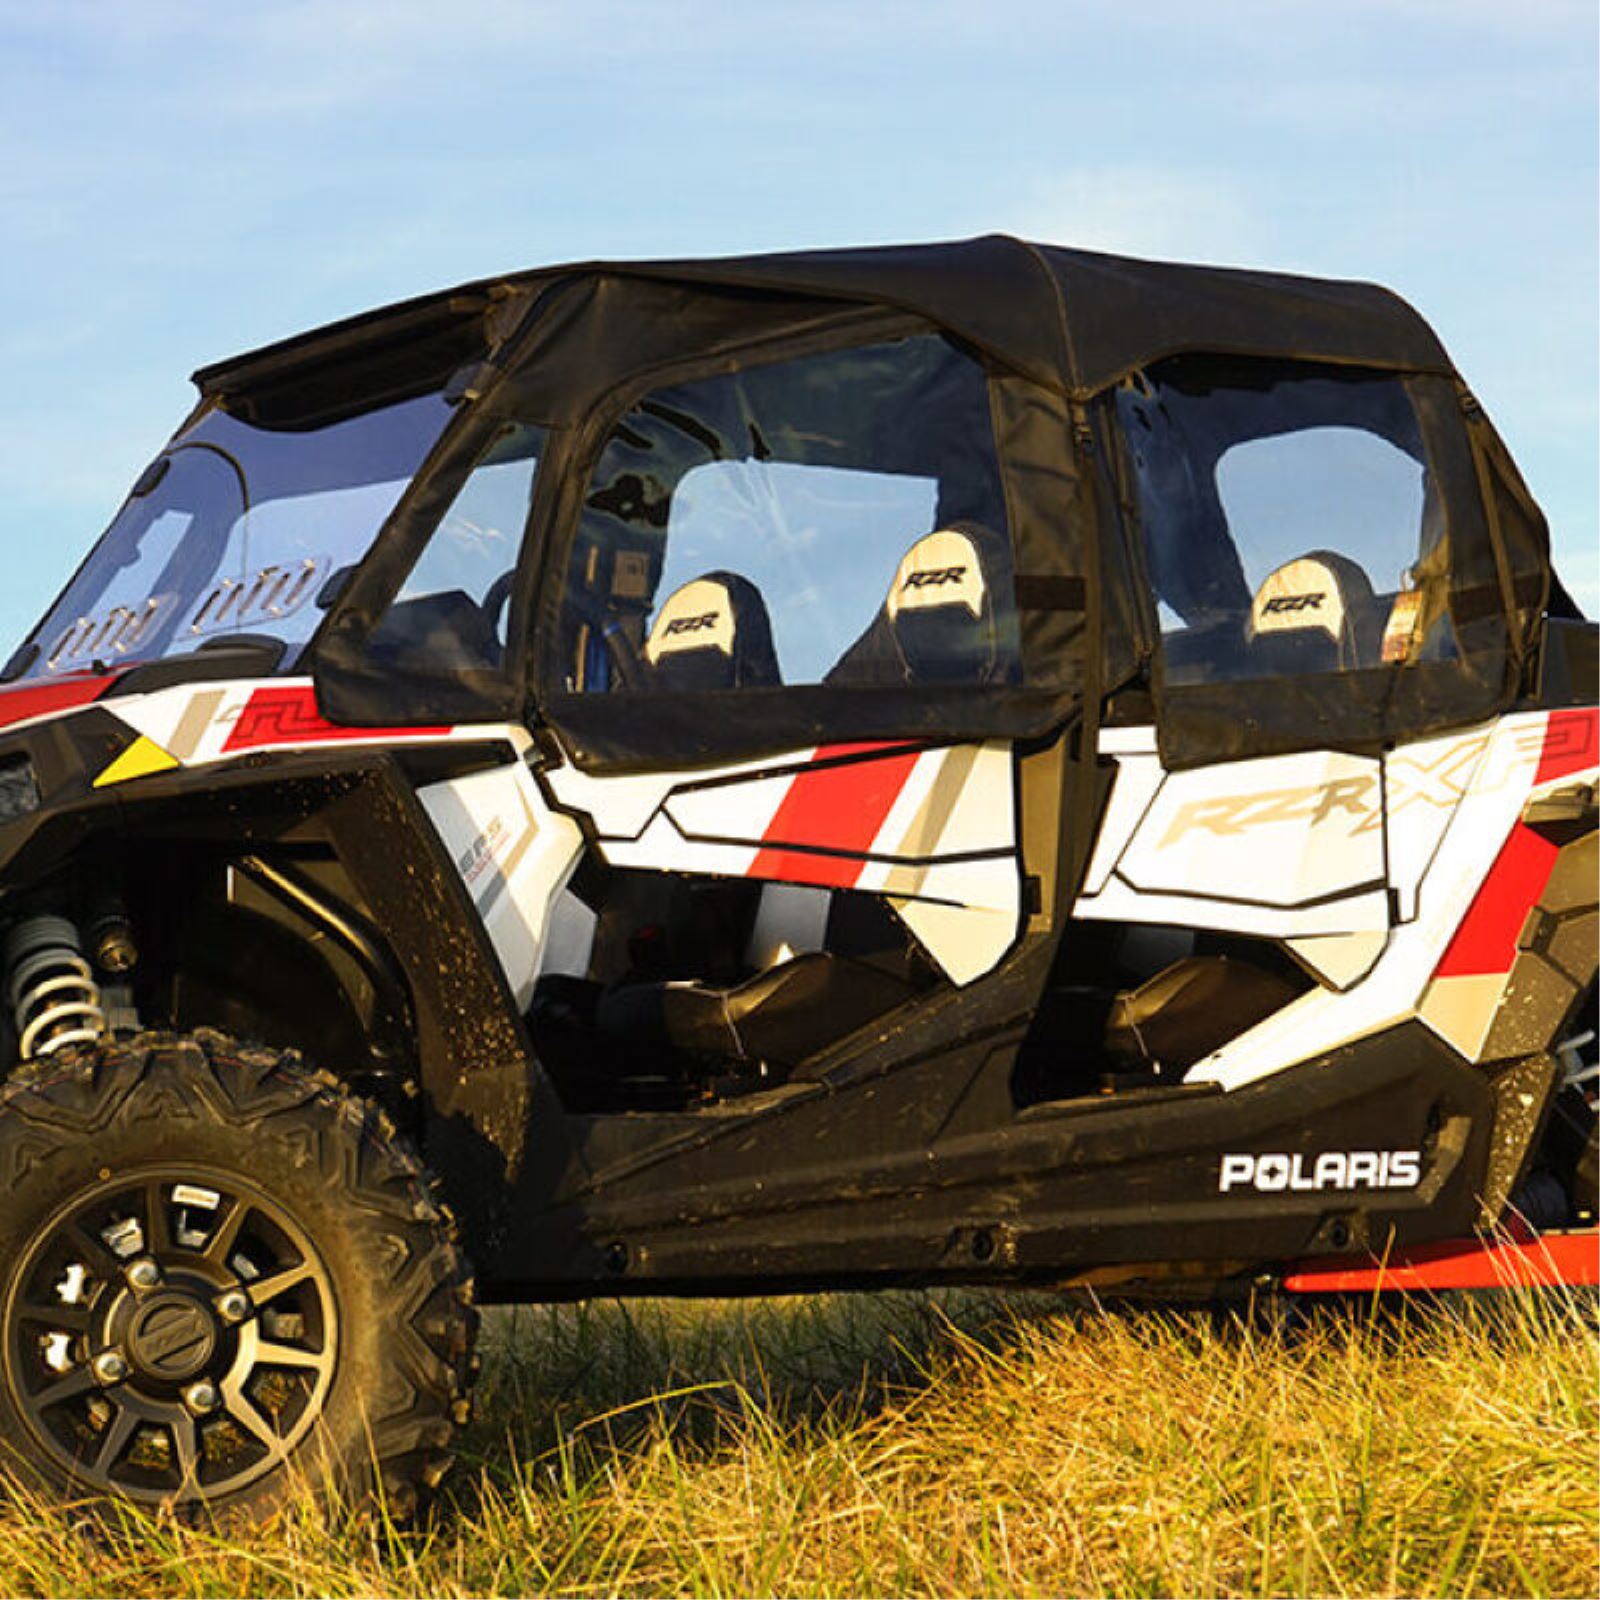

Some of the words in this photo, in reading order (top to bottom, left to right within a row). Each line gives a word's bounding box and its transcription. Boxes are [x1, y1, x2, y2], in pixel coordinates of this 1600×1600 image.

[902, 566, 967, 592] RZR
[1261, 592, 1327, 617] RZR
[661, 610, 720, 639] RZR
[1157, 774, 1377, 851] RZR
[1218, 1150, 1421, 1193] POLARIS
